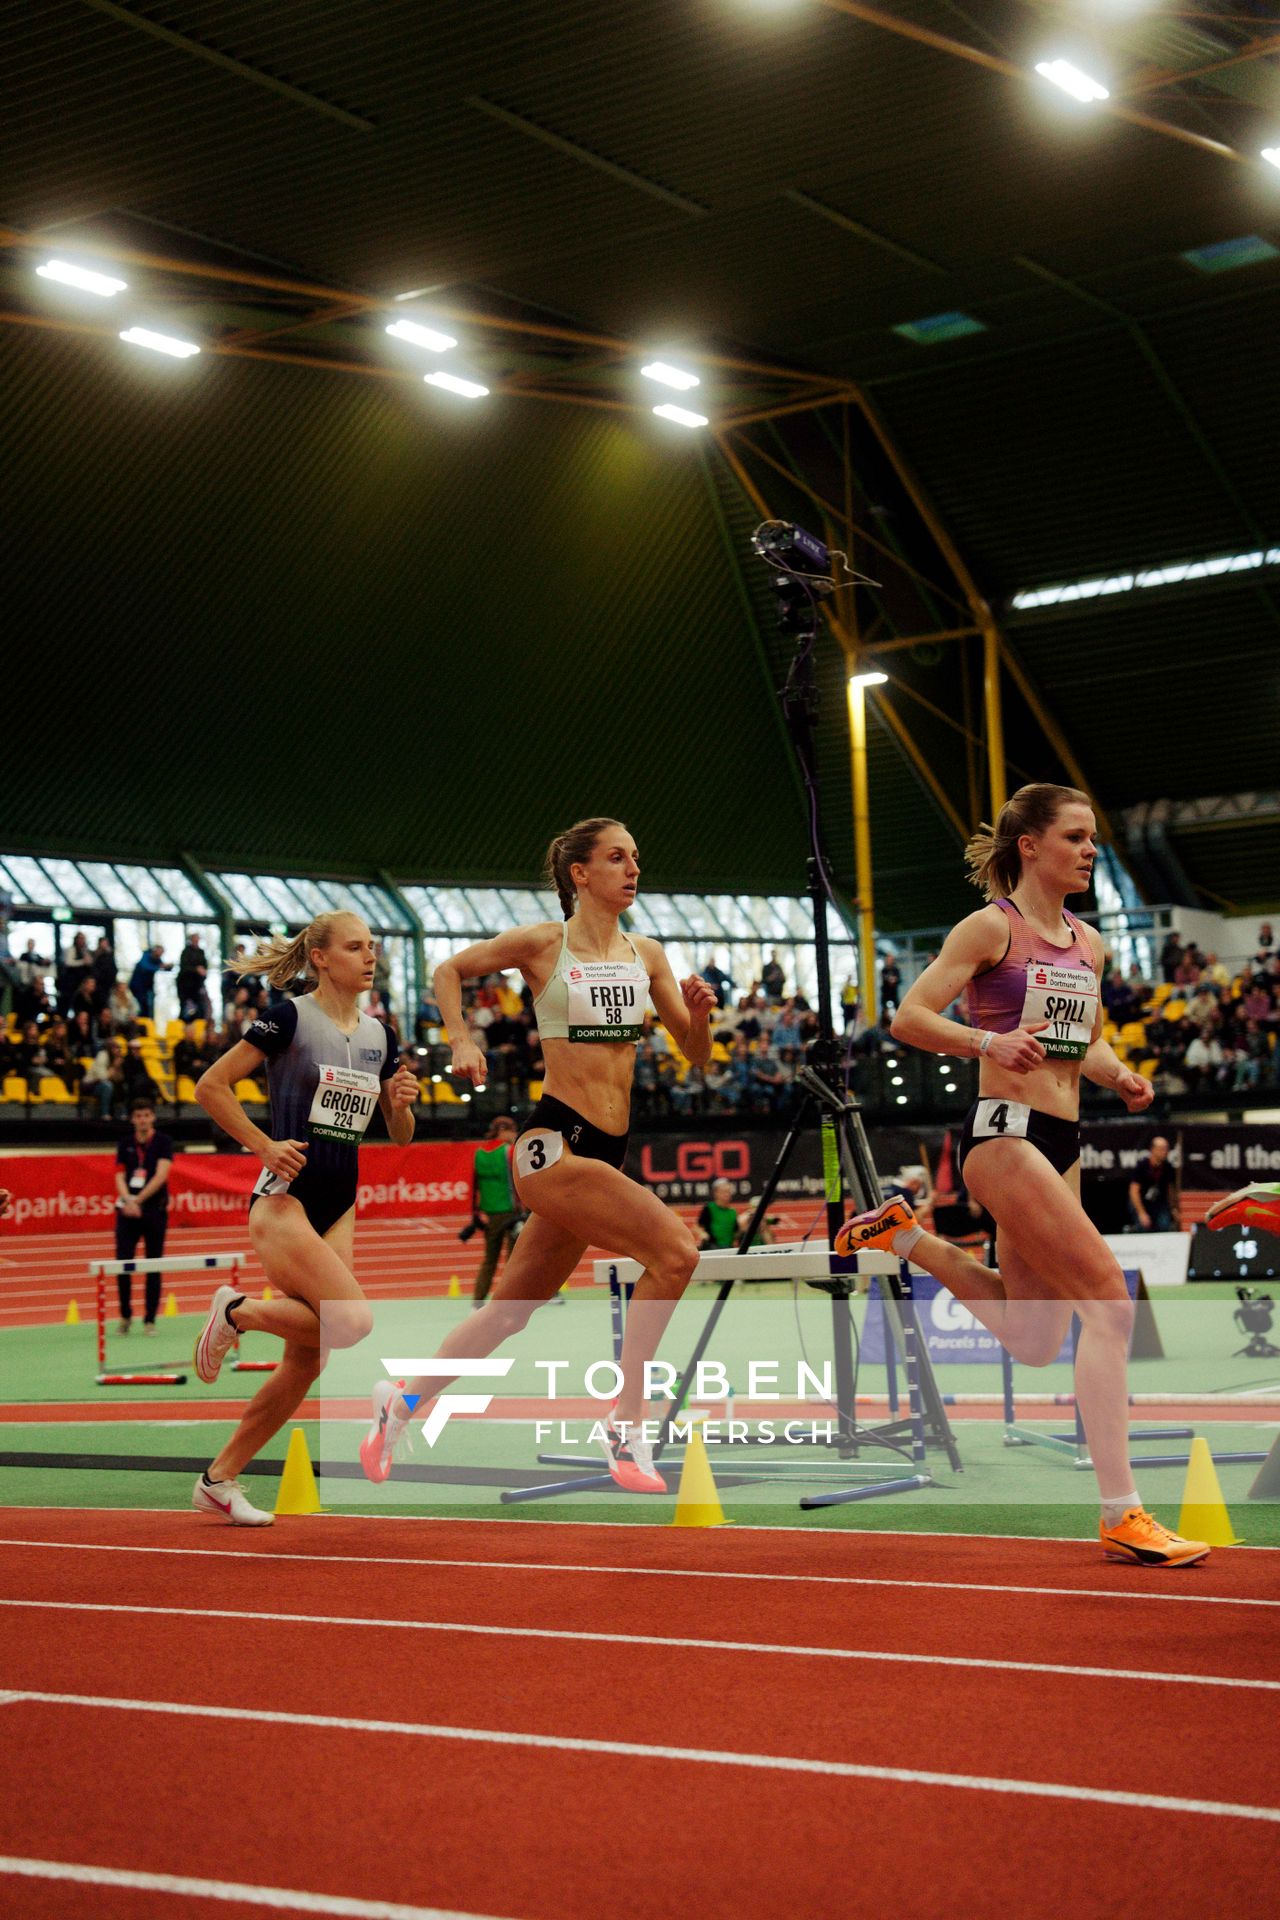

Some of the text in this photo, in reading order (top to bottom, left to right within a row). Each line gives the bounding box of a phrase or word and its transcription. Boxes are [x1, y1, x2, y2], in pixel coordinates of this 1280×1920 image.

[585, 971, 617, 979] Dortmund
[1049, 978, 1077, 989] Dortmund
[1050, 970, 1088, 983] Indoor Meeting
[590, 985, 635, 1007] FREIJ
[605, 1008, 622, 1024] 58
[1044, 996, 1085, 1022] SPILL
[576, 1029, 622, 1038] DORTMUND
[1052, 1020, 1071, 1040] 177
[321, 1087, 372, 1117] GRÖBLI
[333, 1111, 353, 1129] 224
[988, 1103, 1009, 1133] 4
[313, 1126, 347, 1140] DORTMUND
[527, 1139, 547, 1170] 3
[641, 1140, 750, 1182] LGO
[1211, 1143, 1240, 1170] all
[358, 1177, 469, 1211] parkasse
[861, 1213, 902, 1241] NITRO
[928, 1335, 977, 1350] Parcels
[977, 1336, 994, 1349] to
